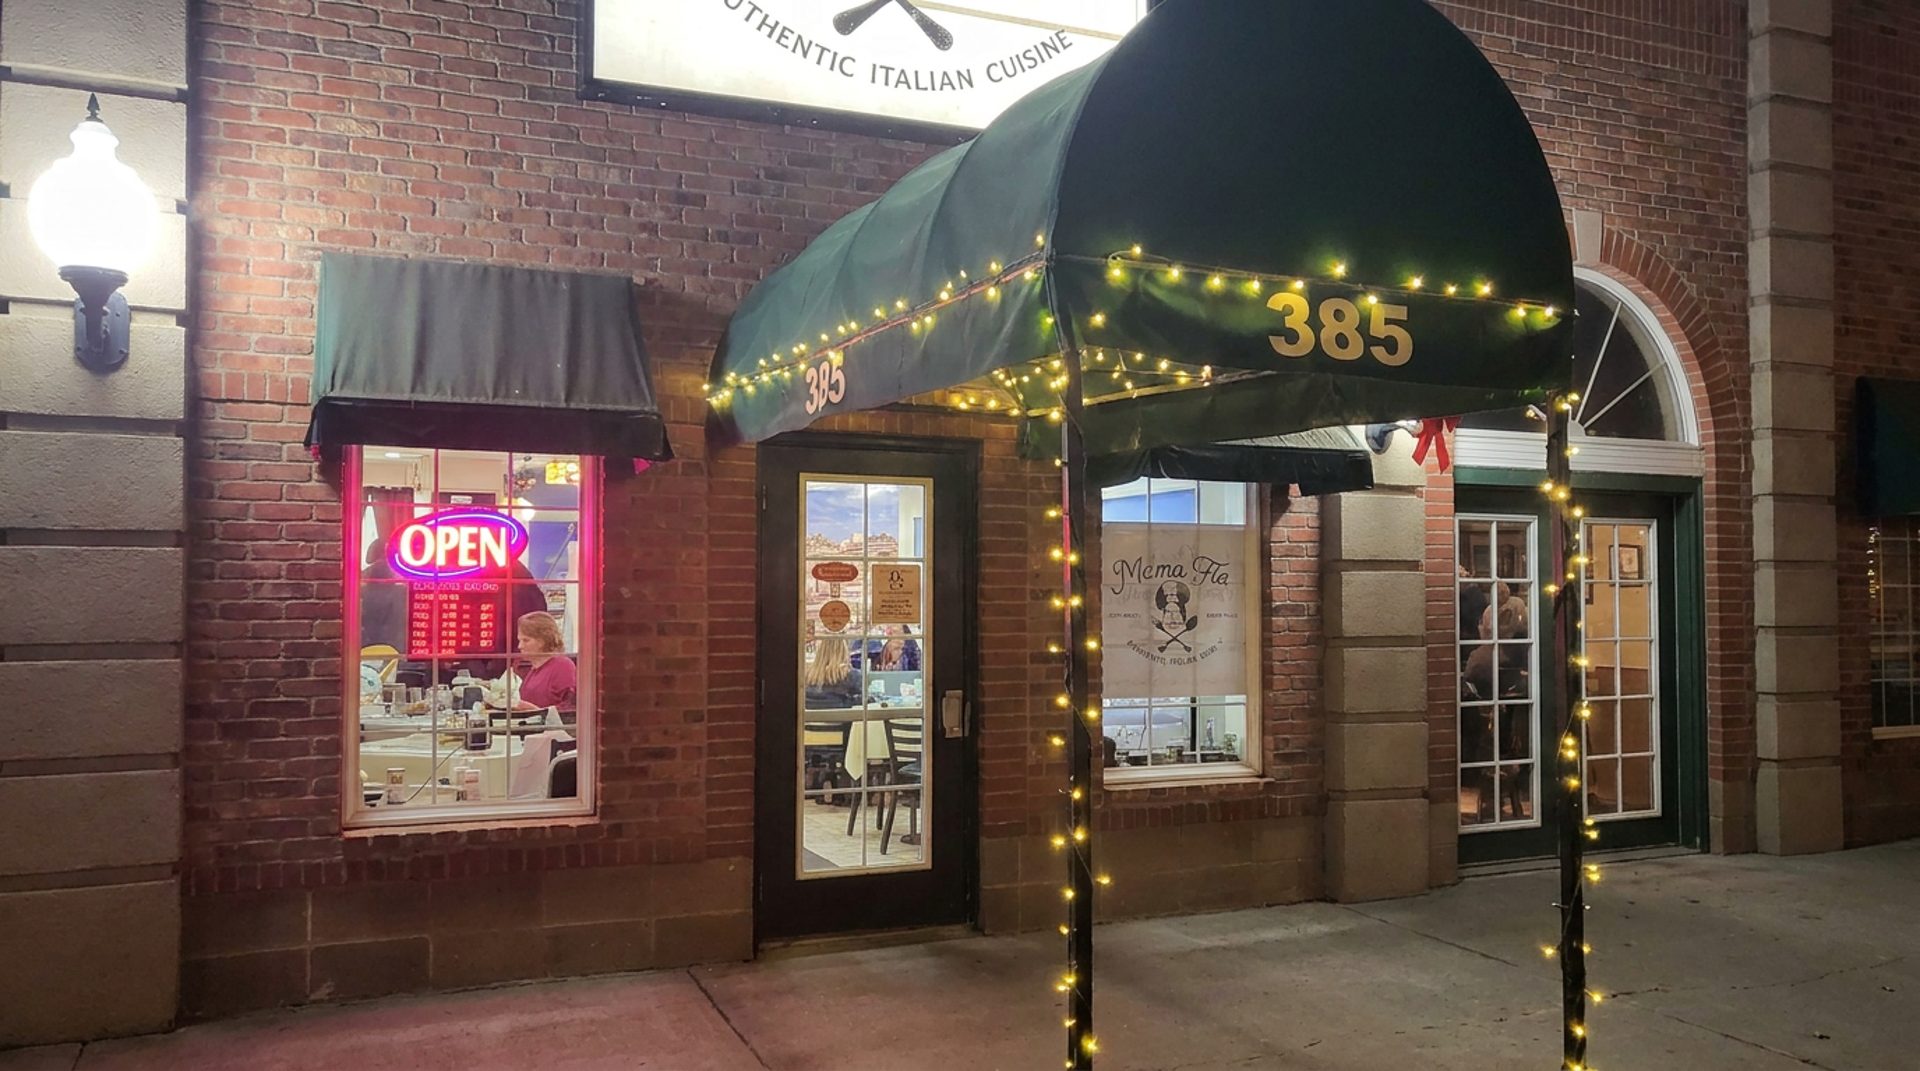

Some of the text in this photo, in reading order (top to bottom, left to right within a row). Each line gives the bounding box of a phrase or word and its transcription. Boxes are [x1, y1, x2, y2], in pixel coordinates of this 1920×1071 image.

[871, 63, 974, 91] ITALIAN
[986, 29, 1073, 83] CUISINE
[1266, 292, 1414, 367] 385
[805, 350, 846, 415] 385
[400, 525, 507, 567] OPEN
